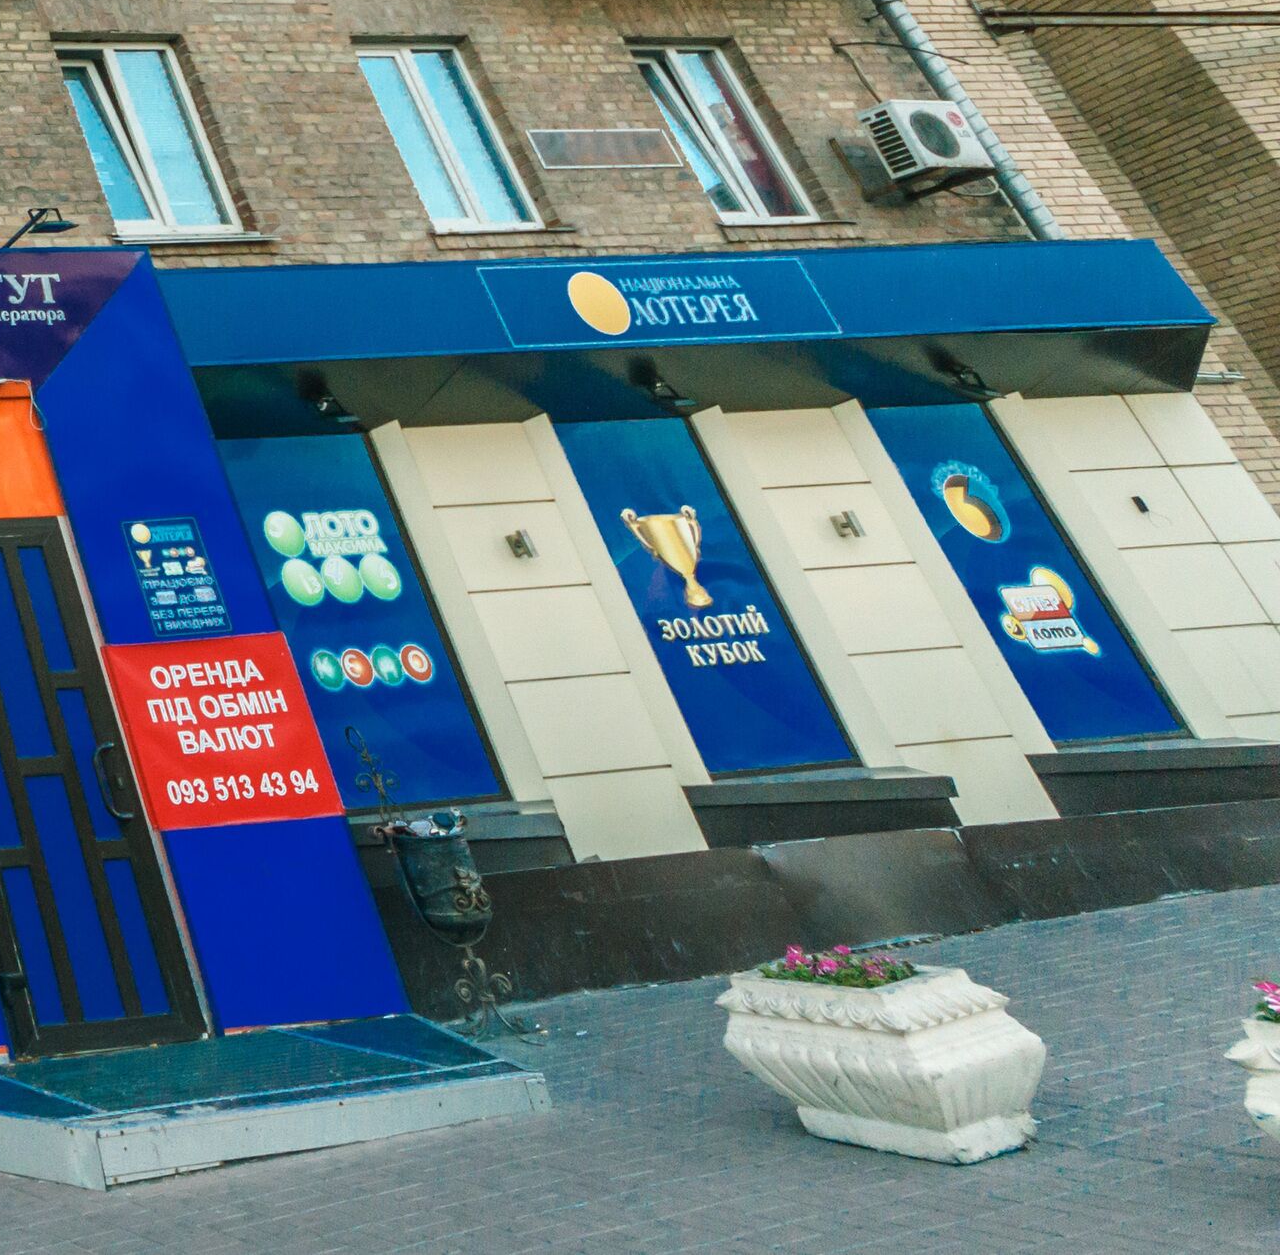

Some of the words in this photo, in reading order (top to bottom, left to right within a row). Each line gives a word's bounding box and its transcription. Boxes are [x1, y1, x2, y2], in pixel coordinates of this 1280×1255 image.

[618, 275, 741, 295] НАЦІОНАЛЬНА
[634, 294, 759, 326] ЛОТЕРЕЯ
[302, 510, 379, 539] ЛОТО
[151, 608, 175, 620] БЕЗ
[657, 605, 770, 642] ЗОЛОТИЙ
[685, 640, 766, 667] КУБОК
[149, 659, 264, 689] ОРЕНДА
[146, 697, 198, 725] ПІД
[199, 690, 288, 719] ОБМІН
[177, 724, 275, 755] ВАЛЮТ
[166, 779, 209, 805] 093
[213, 775, 255, 801] 513
[260, 771, 287, 797] 43
[289, 768, 319, 794] 94
